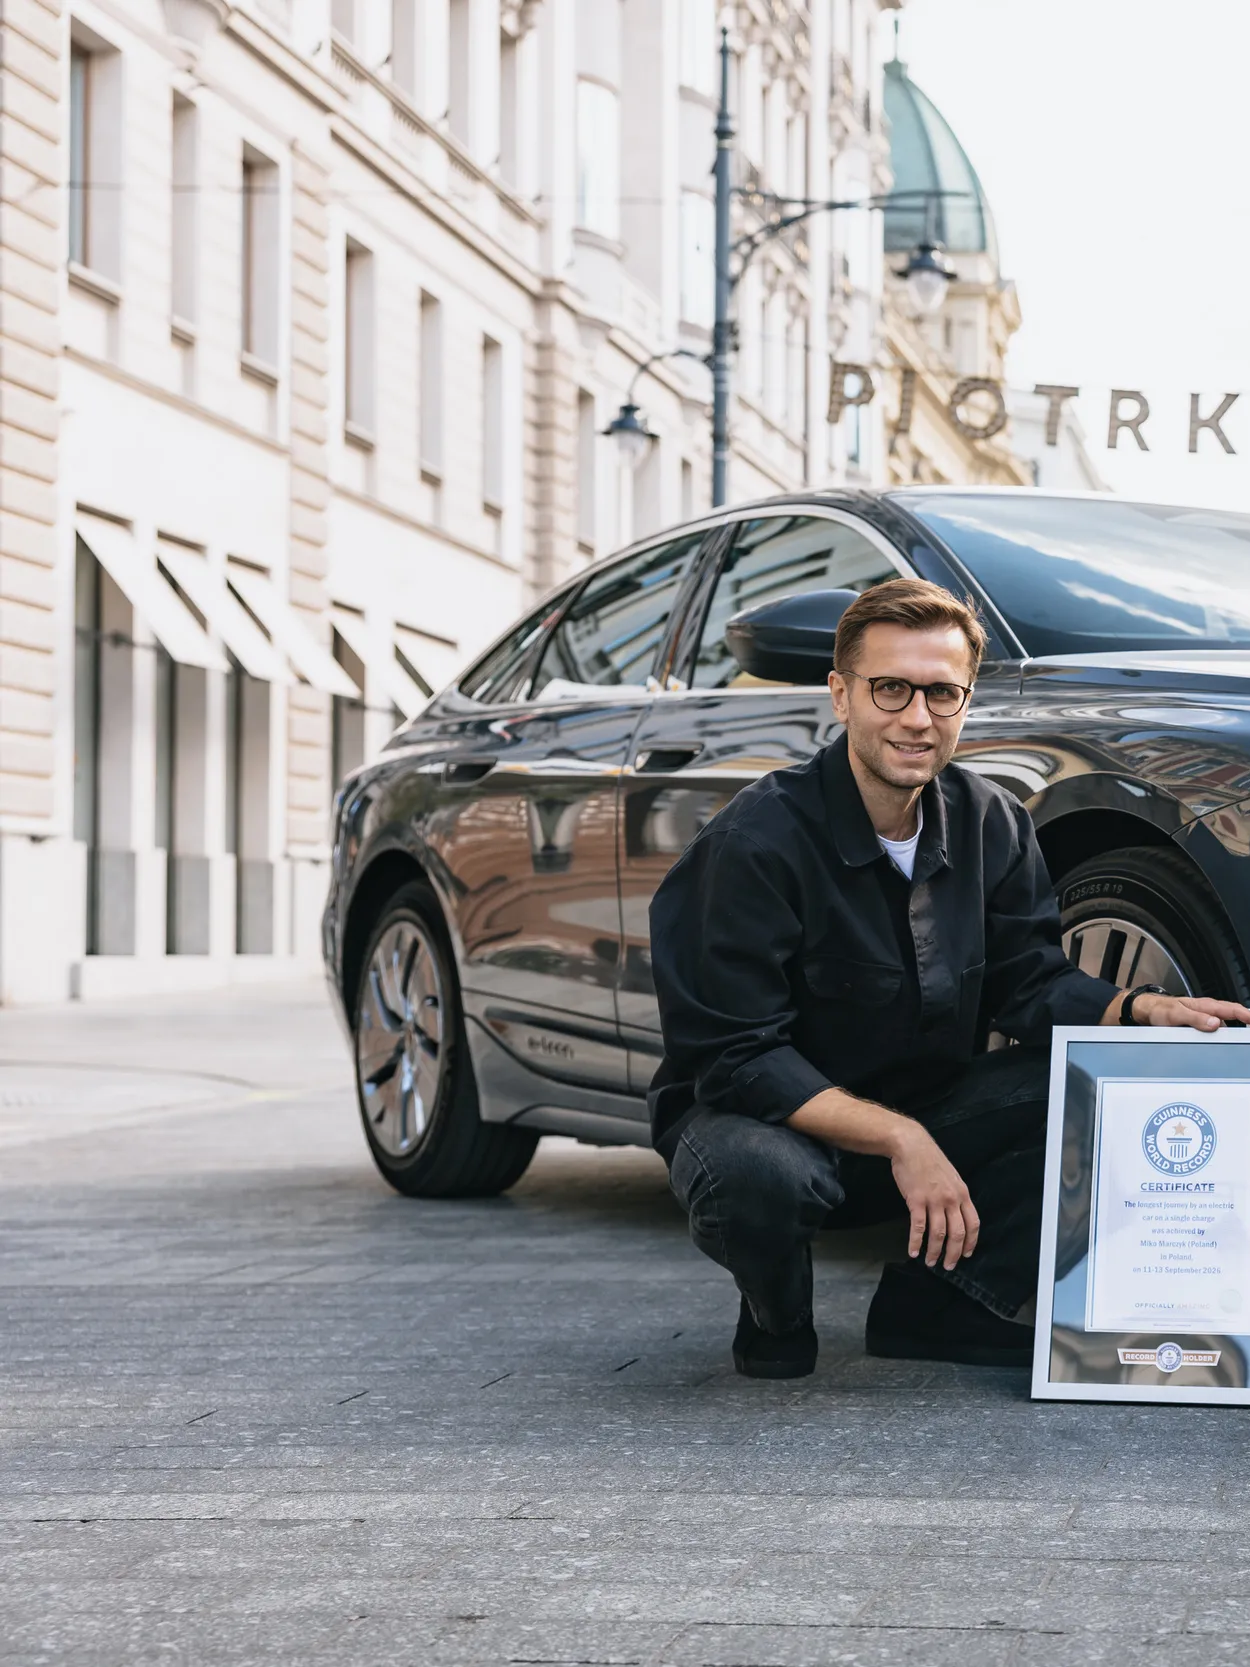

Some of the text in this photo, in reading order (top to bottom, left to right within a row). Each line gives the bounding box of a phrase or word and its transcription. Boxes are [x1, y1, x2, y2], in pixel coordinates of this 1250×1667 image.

[1153, 1106, 1208, 1126] GUINNESS
[1146, 1134, 1213, 1173] WORLD RECORDS
[1140, 1182, 1215, 1192] CERTIFICATE
[1137, 1201, 1162, 1209] longest
[1163, 1201, 1188, 1210] journey
[1189, 1202, 1197, 1210] by
[1208, 1202, 1234, 1210] electric
[1170, 1214, 1191, 1222] single
[1192, 1215, 1215, 1223] charge
[1197, 1228, 1205, 1236] by
[1158, 1240, 1186, 1249] Marczyk
[1187, 1240, 1217, 1249] (Poland)
[1164, 1266, 1201, 1275] September
[1125, 1353, 1213, 1362] RECORD HOLDER
